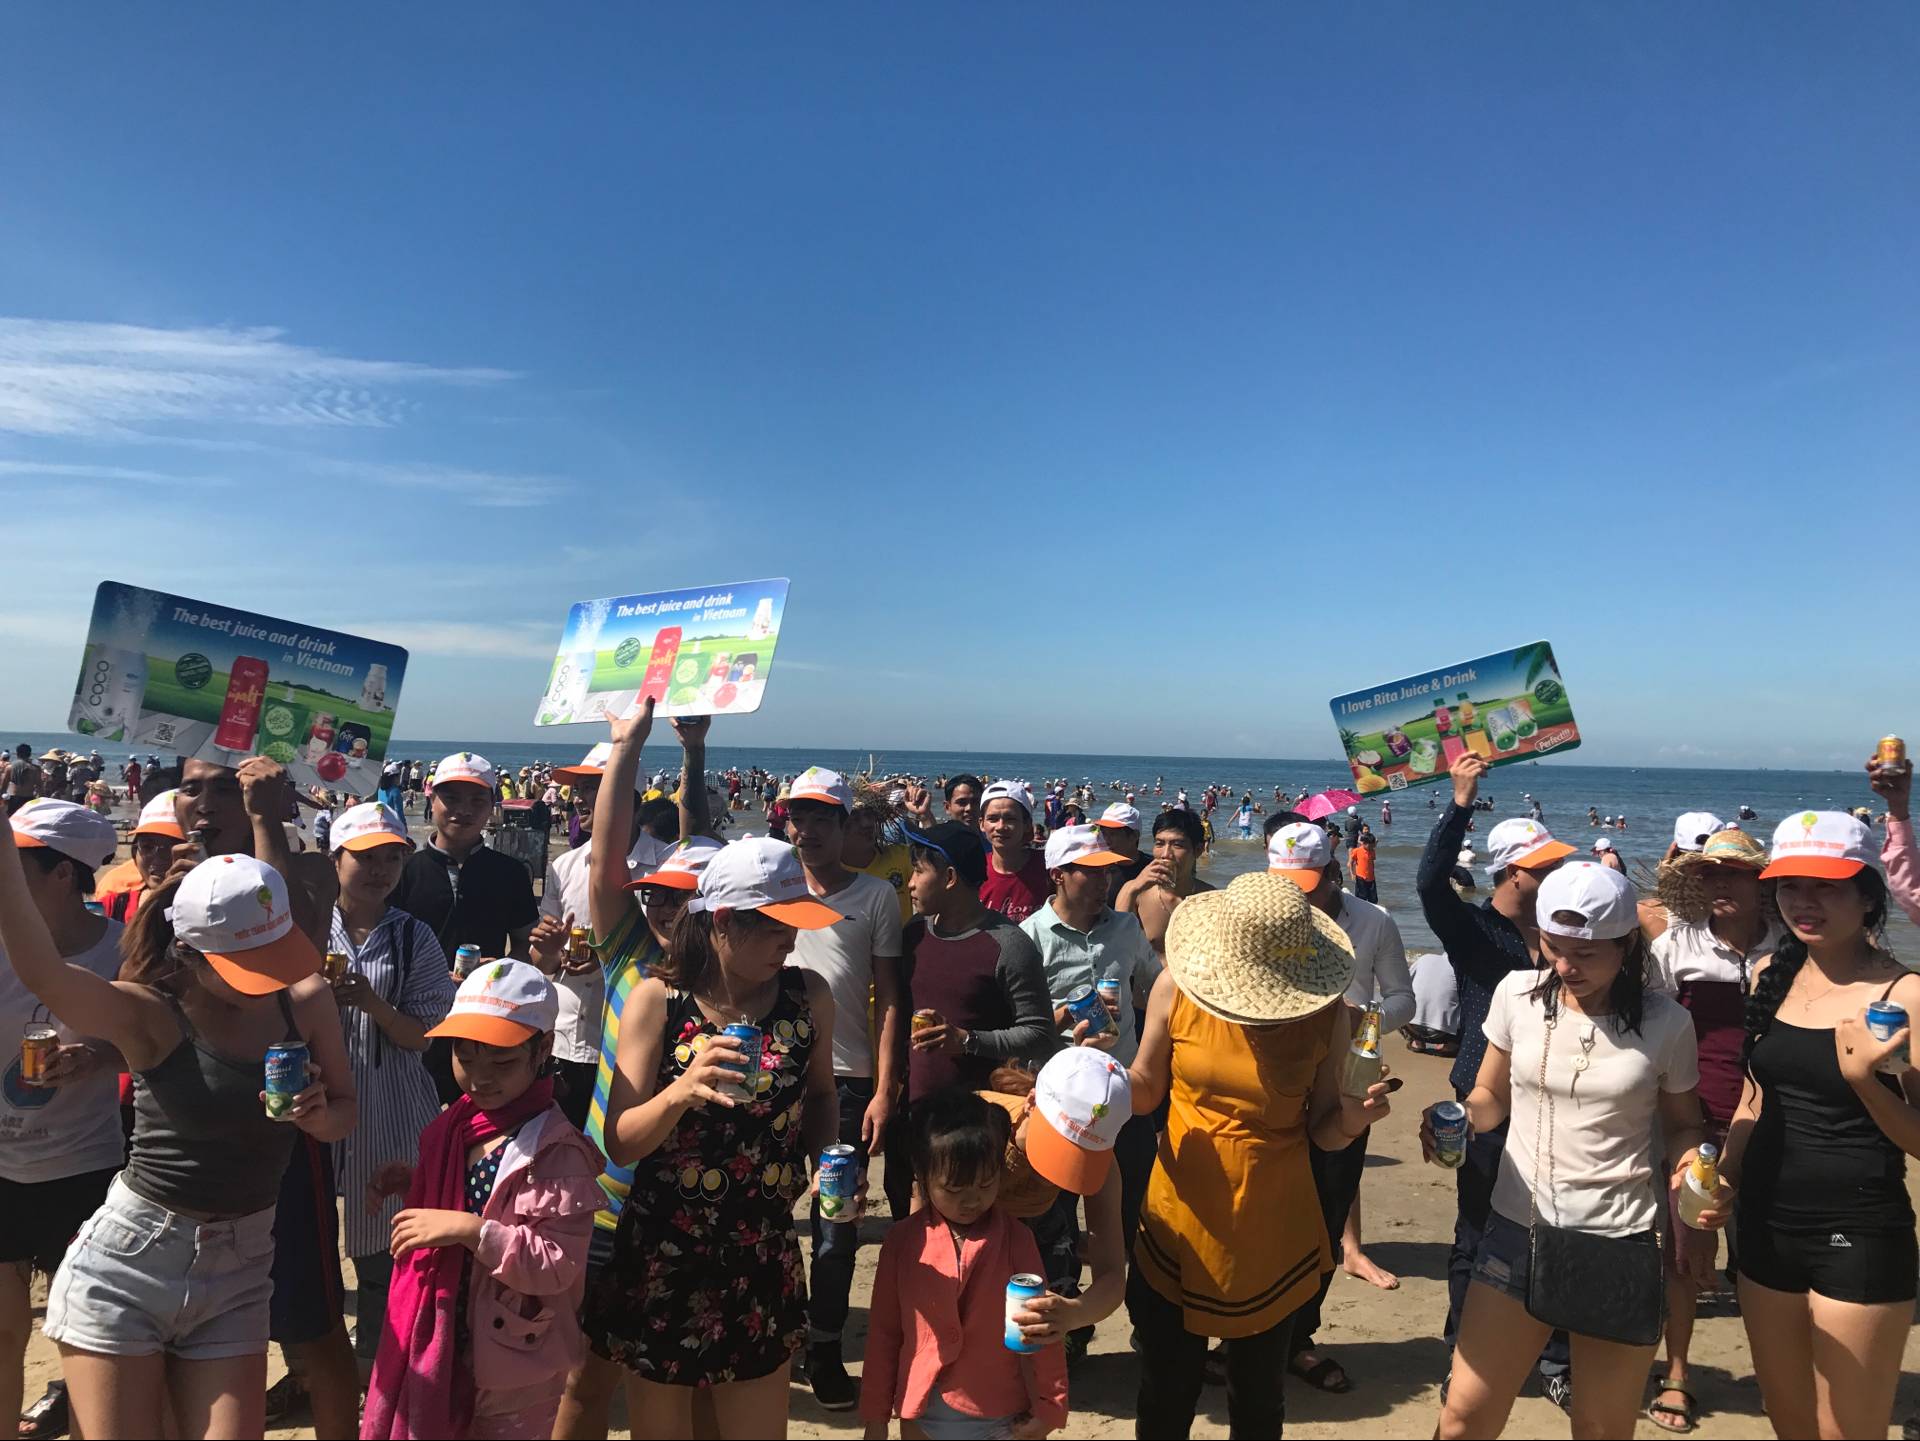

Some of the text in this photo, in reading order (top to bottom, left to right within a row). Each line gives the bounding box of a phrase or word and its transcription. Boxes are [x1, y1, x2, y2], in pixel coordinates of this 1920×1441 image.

[616, 592, 734, 617] The best juice and drink
[692, 608, 747, 622] in Vietnam
[172, 607, 337, 656] The best juice and drink
[282, 651, 354, 676] in Vietnam
[1340, 668, 1477, 715] I love Rita Juice & Drink
